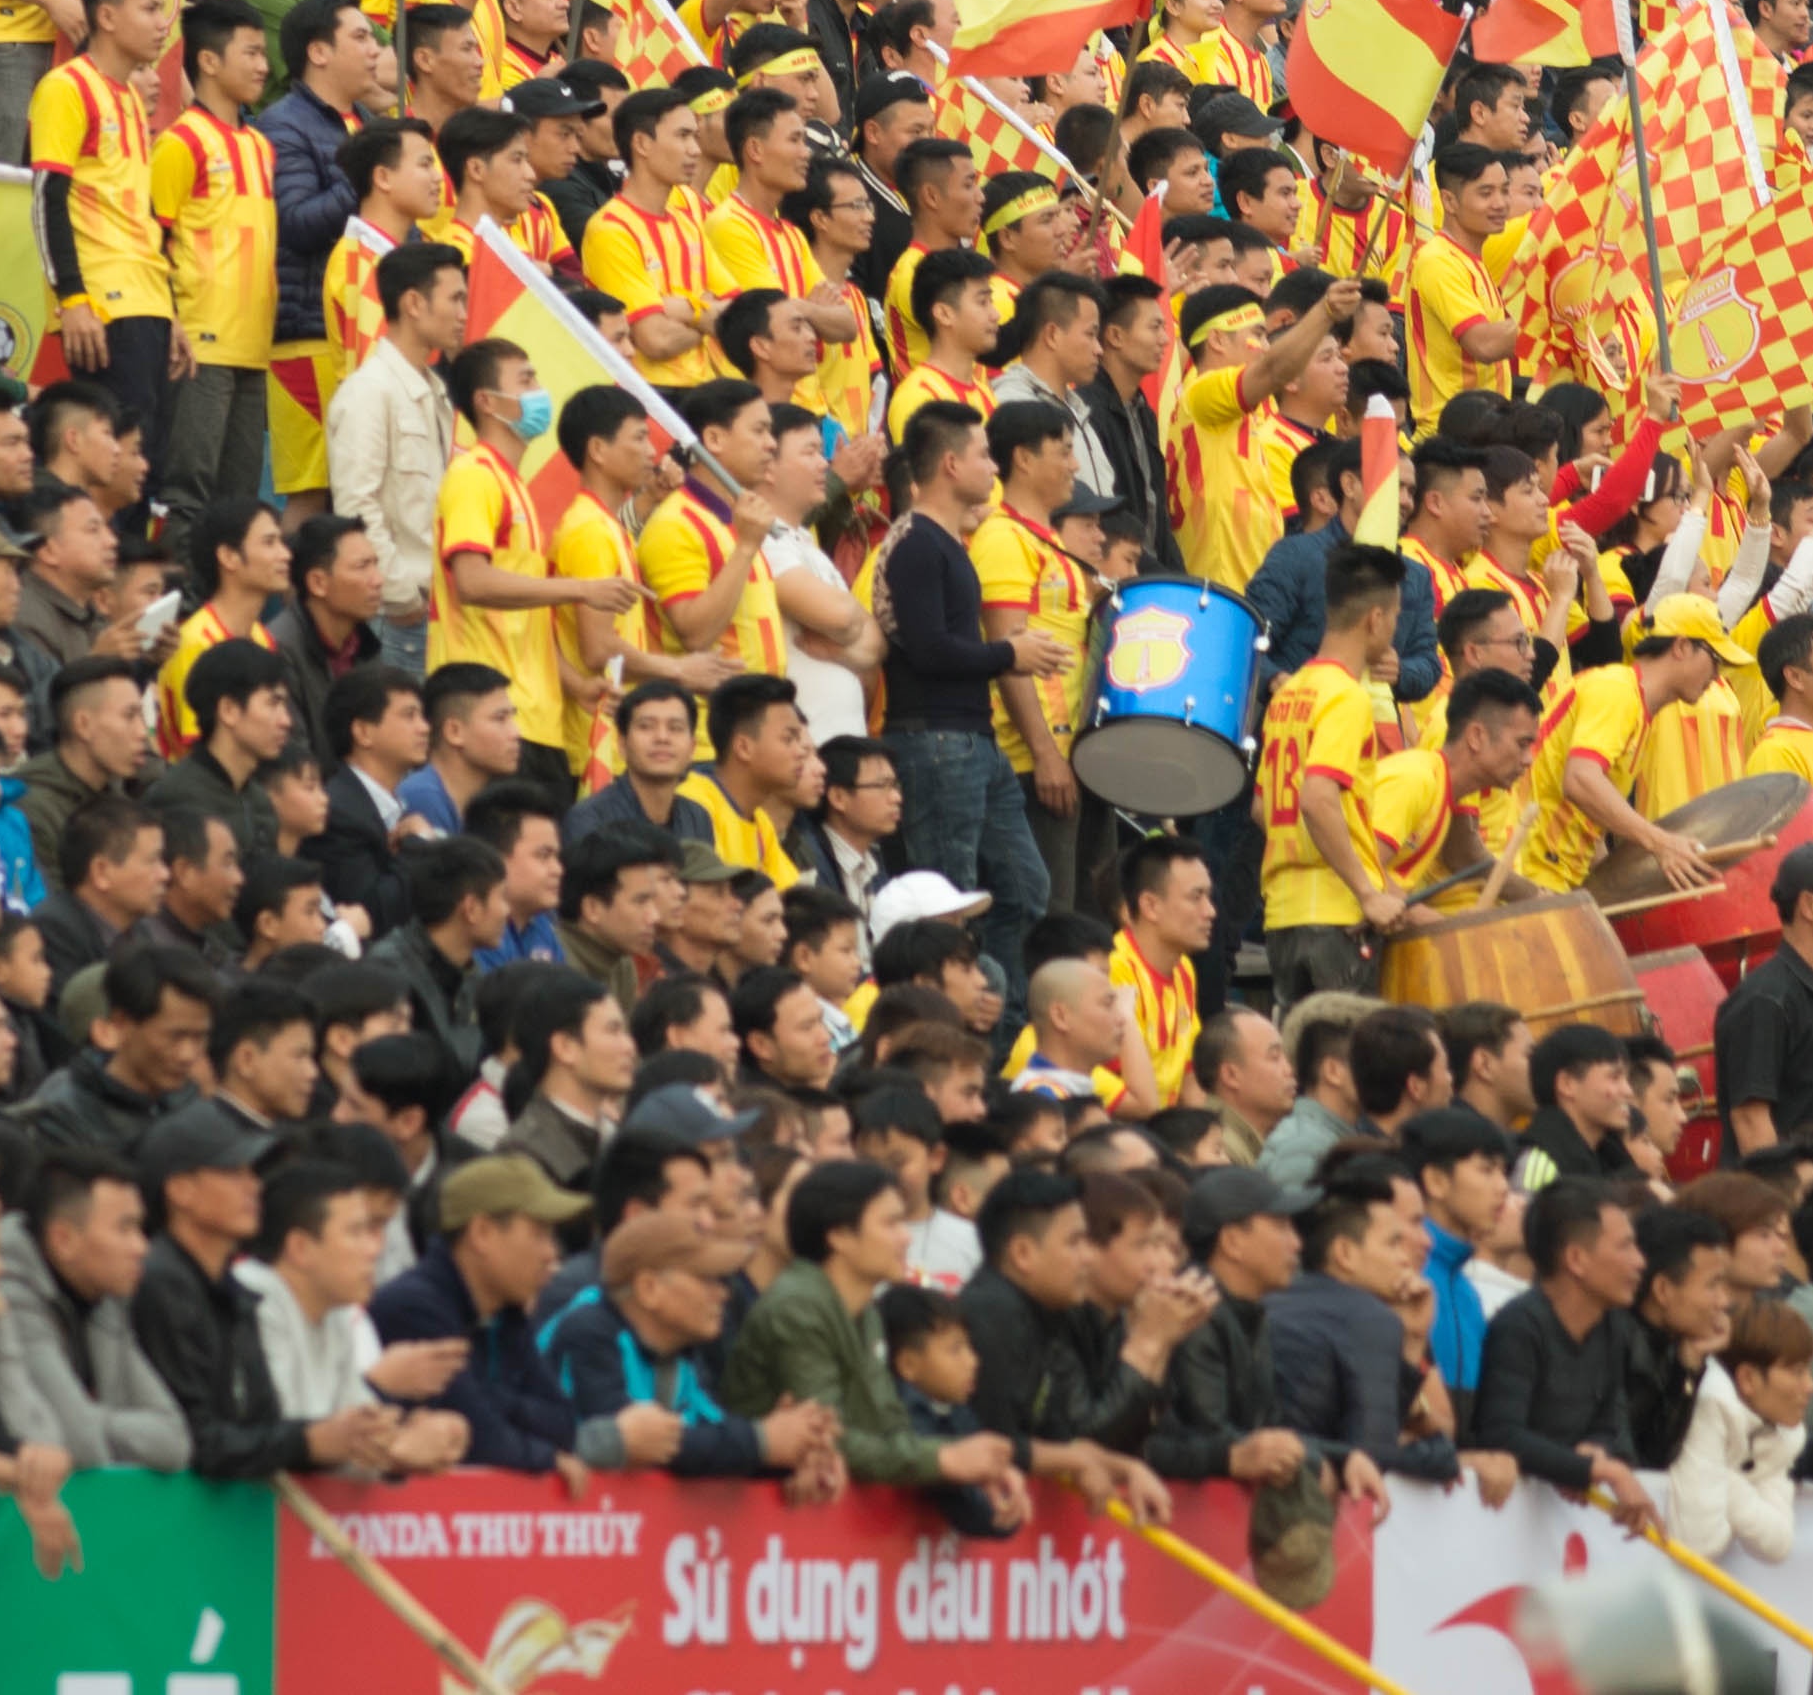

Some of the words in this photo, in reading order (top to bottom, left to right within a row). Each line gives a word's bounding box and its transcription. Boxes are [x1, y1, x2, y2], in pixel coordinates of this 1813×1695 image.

[452, 1511, 534, 1558] THU
[663, 1525, 730, 1646] Sử
[746, 1534, 878, 1671] dụng
[1006, 1534, 1127, 1642] nhớt
